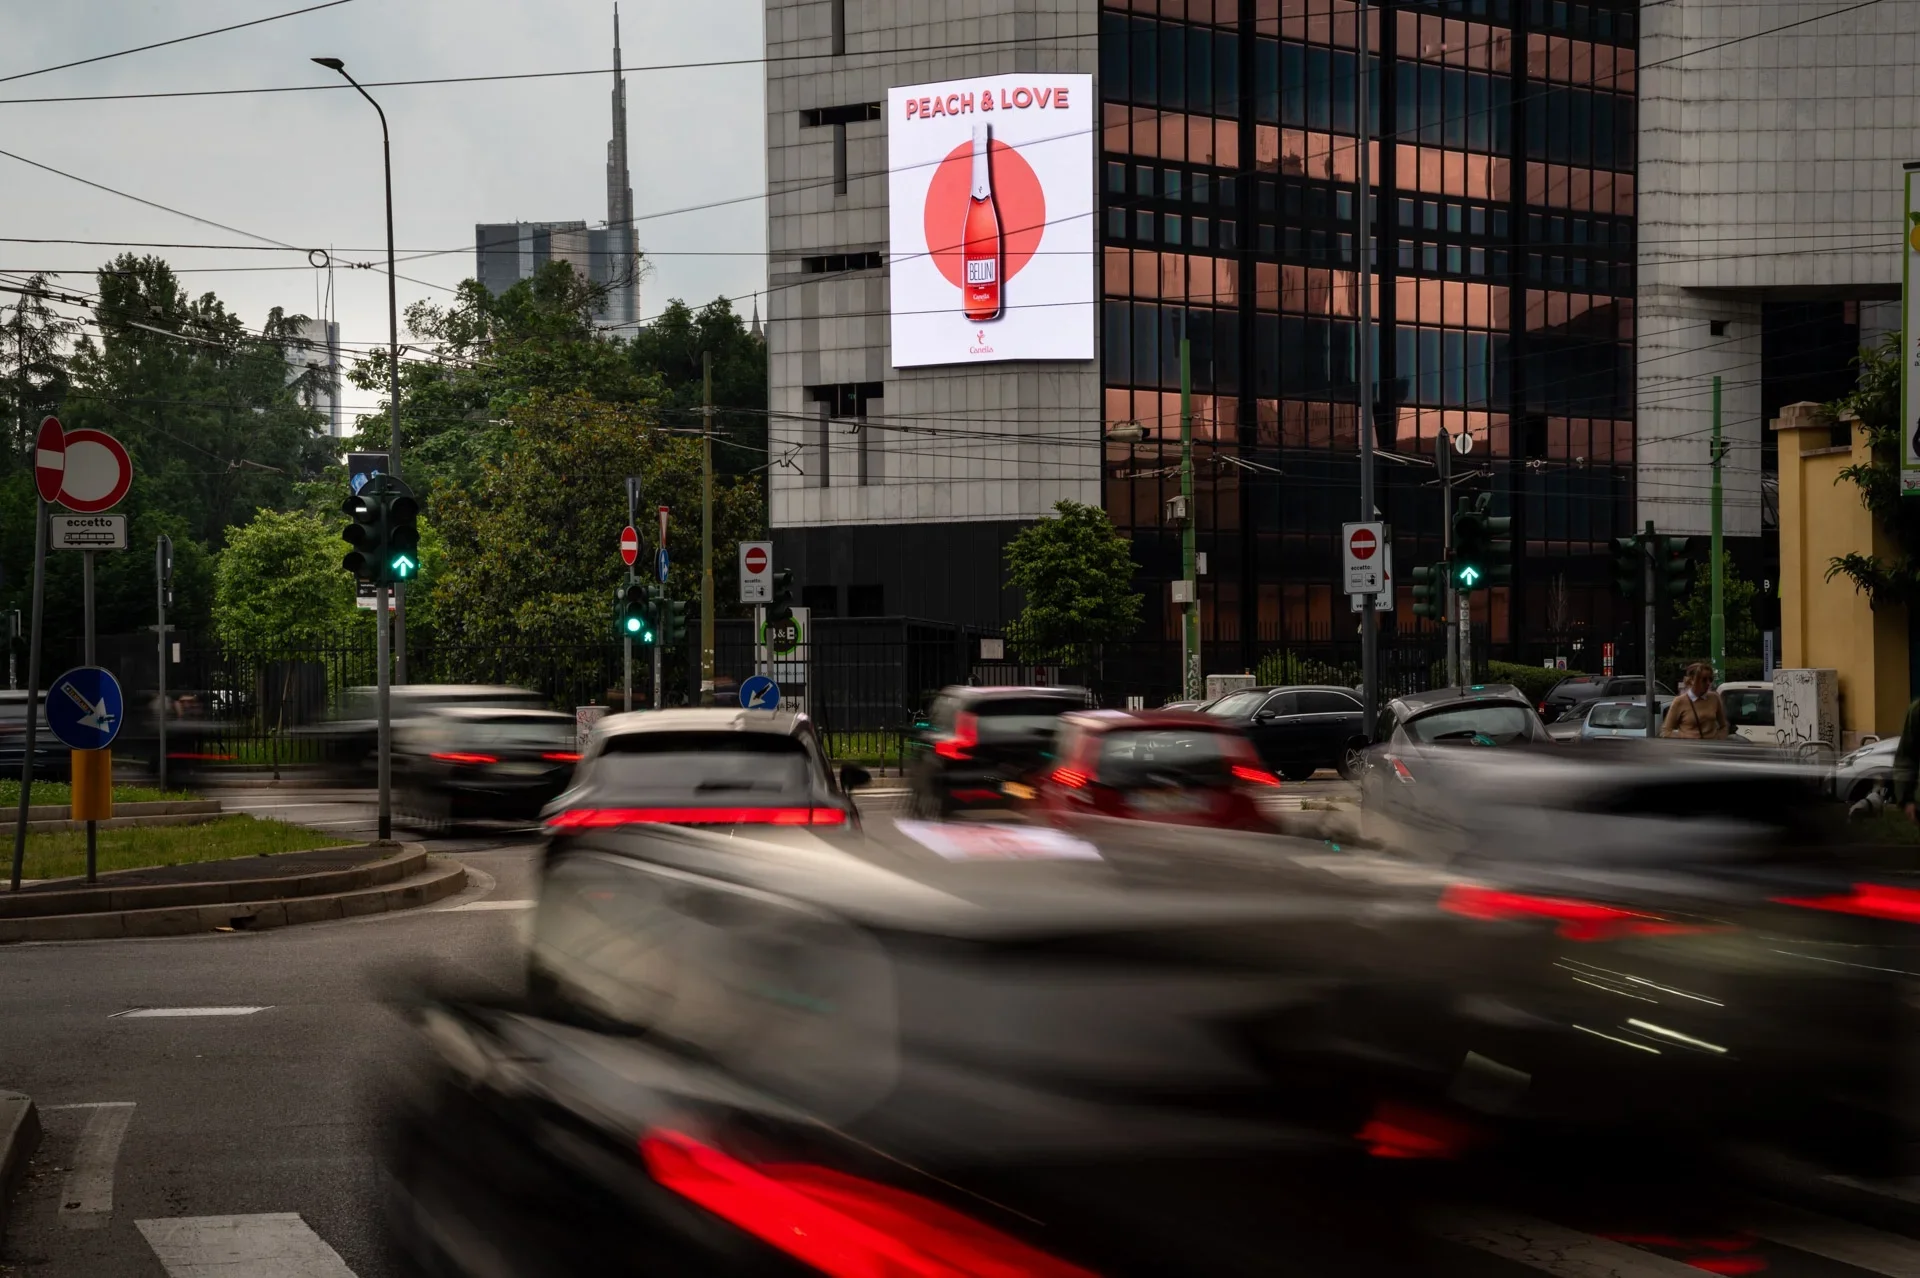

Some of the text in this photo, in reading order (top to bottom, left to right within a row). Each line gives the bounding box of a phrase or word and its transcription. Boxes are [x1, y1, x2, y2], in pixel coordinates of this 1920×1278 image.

[906, 87, 1069, 120] PEACH & LOVE
[969, 262, 994, 281] BELLINI
[969, 346, 994, 354] Canella
[66, 518, 112, 527] eccetto
